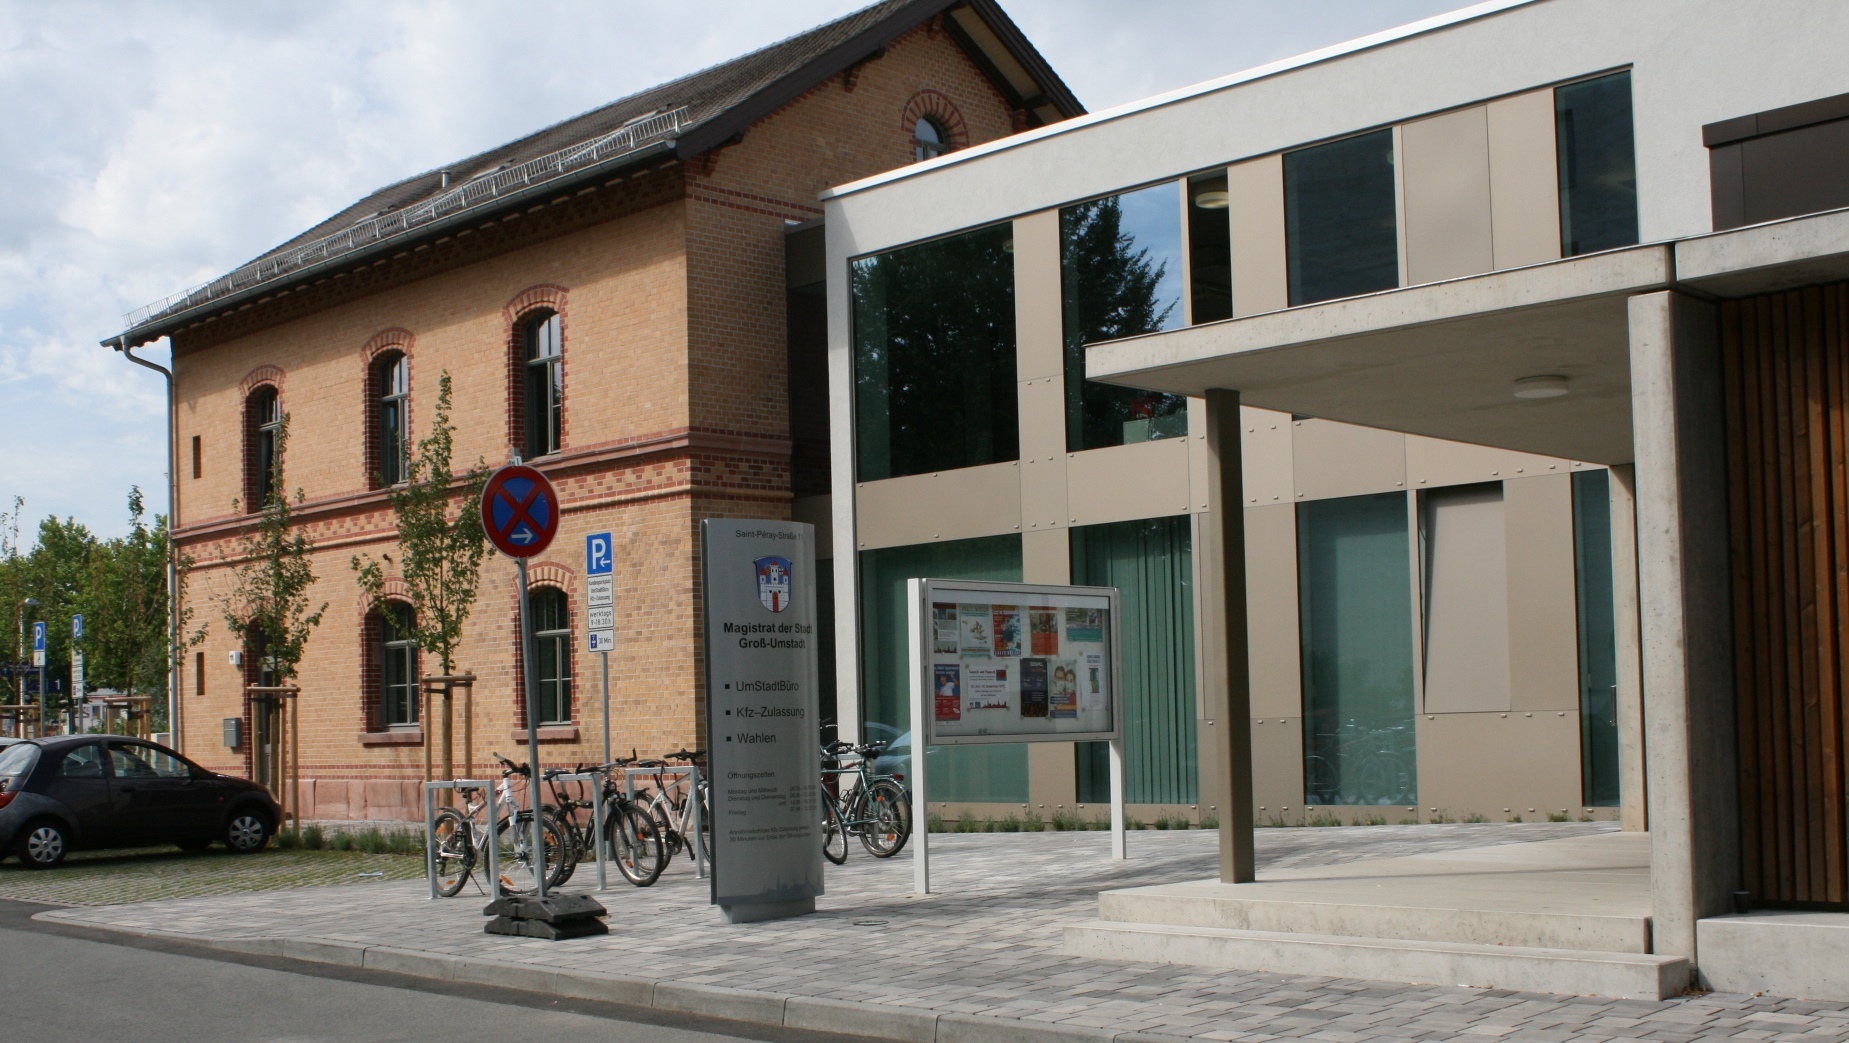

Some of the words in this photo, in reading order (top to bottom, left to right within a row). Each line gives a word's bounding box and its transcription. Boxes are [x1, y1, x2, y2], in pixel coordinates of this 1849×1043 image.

[735, 530, 796, 540] Saint-Péray-Straße
[592, 538, 606, 570] P
[590, 610, 612, 618] werktags
[723, 622, 776, 635] Magistrat
[778, 622, 792, 633] der
[35, 626, 42, 647] P
[739, 638, 805, 648] Groß-Umstadt
[736, 680, 799, 691] UmStadtBüro
[736, 706, 804, 718] Kfz-Zulassung
[737, 733, 776, 744] Wahlen
[728, 771, 775, 780] Öffnungszeiten
